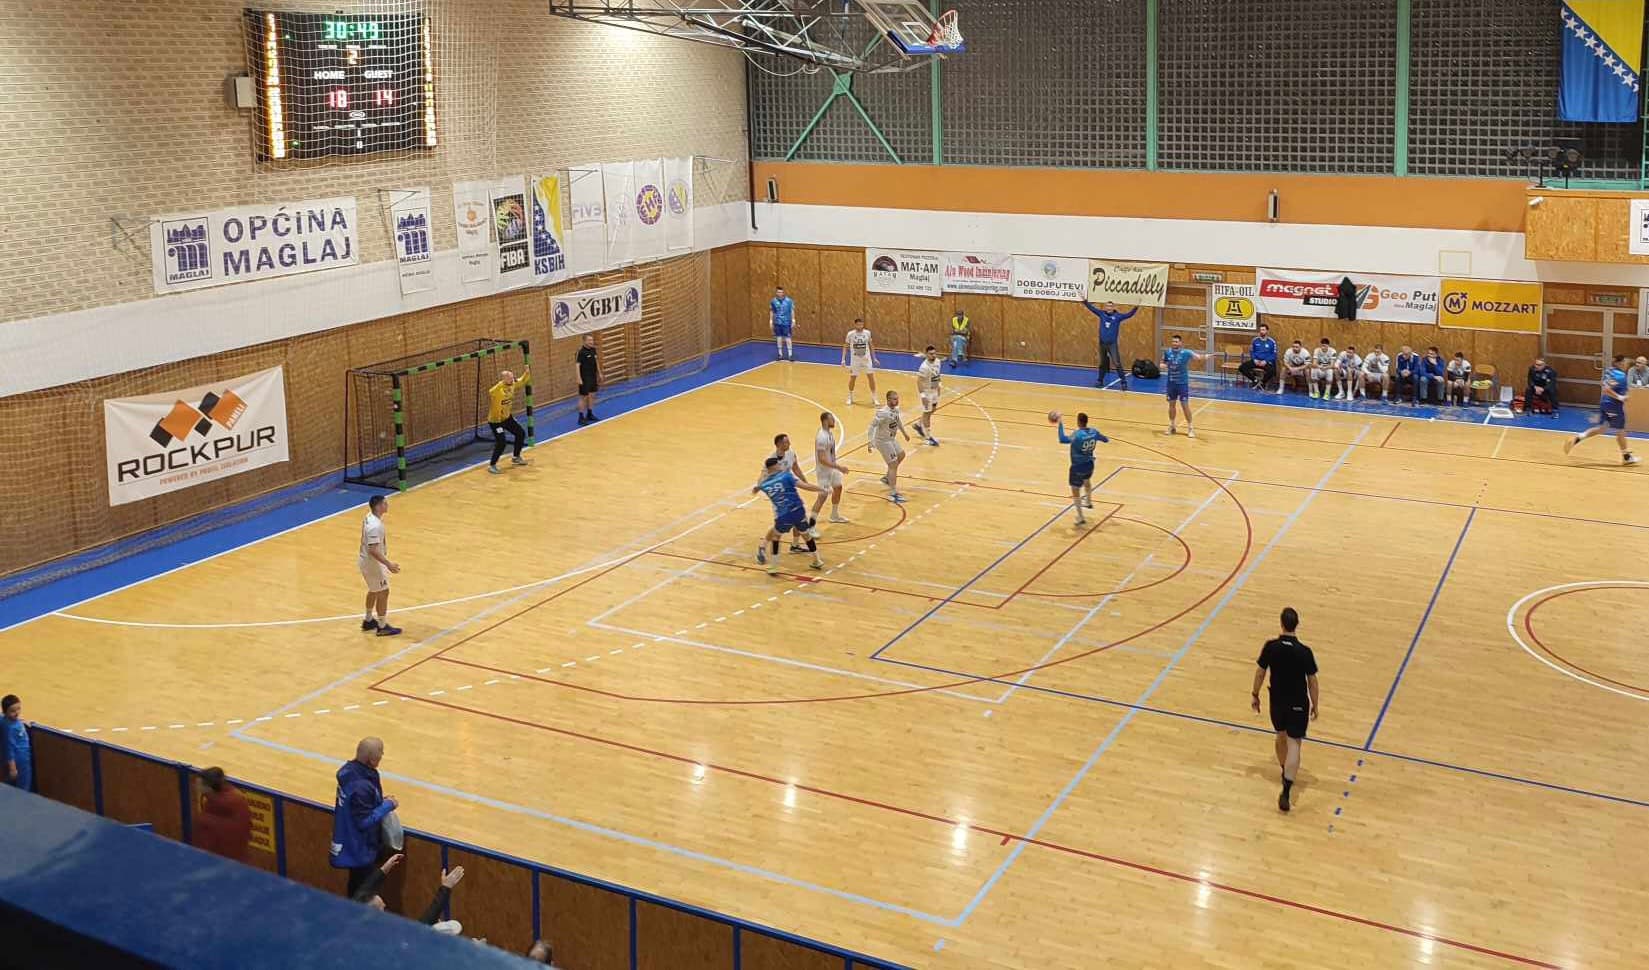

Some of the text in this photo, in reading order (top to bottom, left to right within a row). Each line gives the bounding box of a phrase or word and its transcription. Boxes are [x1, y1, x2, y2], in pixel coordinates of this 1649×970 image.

[314, 70, 393, 80] HOME GUEST
[377, 90, 392, 105] 14
[223, 206, 347, 243] OPĆINA
[223, 236, 350, 276] MAGLAJ
[501, 249, 525, 269] FIBA
[534, 254, 565, 275] KSBIH
[169, 269, 209, 281] MAGLAJ
[1017, 280, 1084, 290] DOBOJPUTEVI
[1093, 268, 1164, 302] Piccadilly
[1214, 284, 1254, 297] HIFA-OIL
[1266, 283, 1335, 296] magnet
[1309, 297, 1337, 305] STUDIO
[1380, 289, 1436, 301] Geo Put
[1405, 302, 1436, 311] Maglaj
[1471, 301, 1538, 314] MOZZART
[117, 426, 275, 482] ROCKPUR
